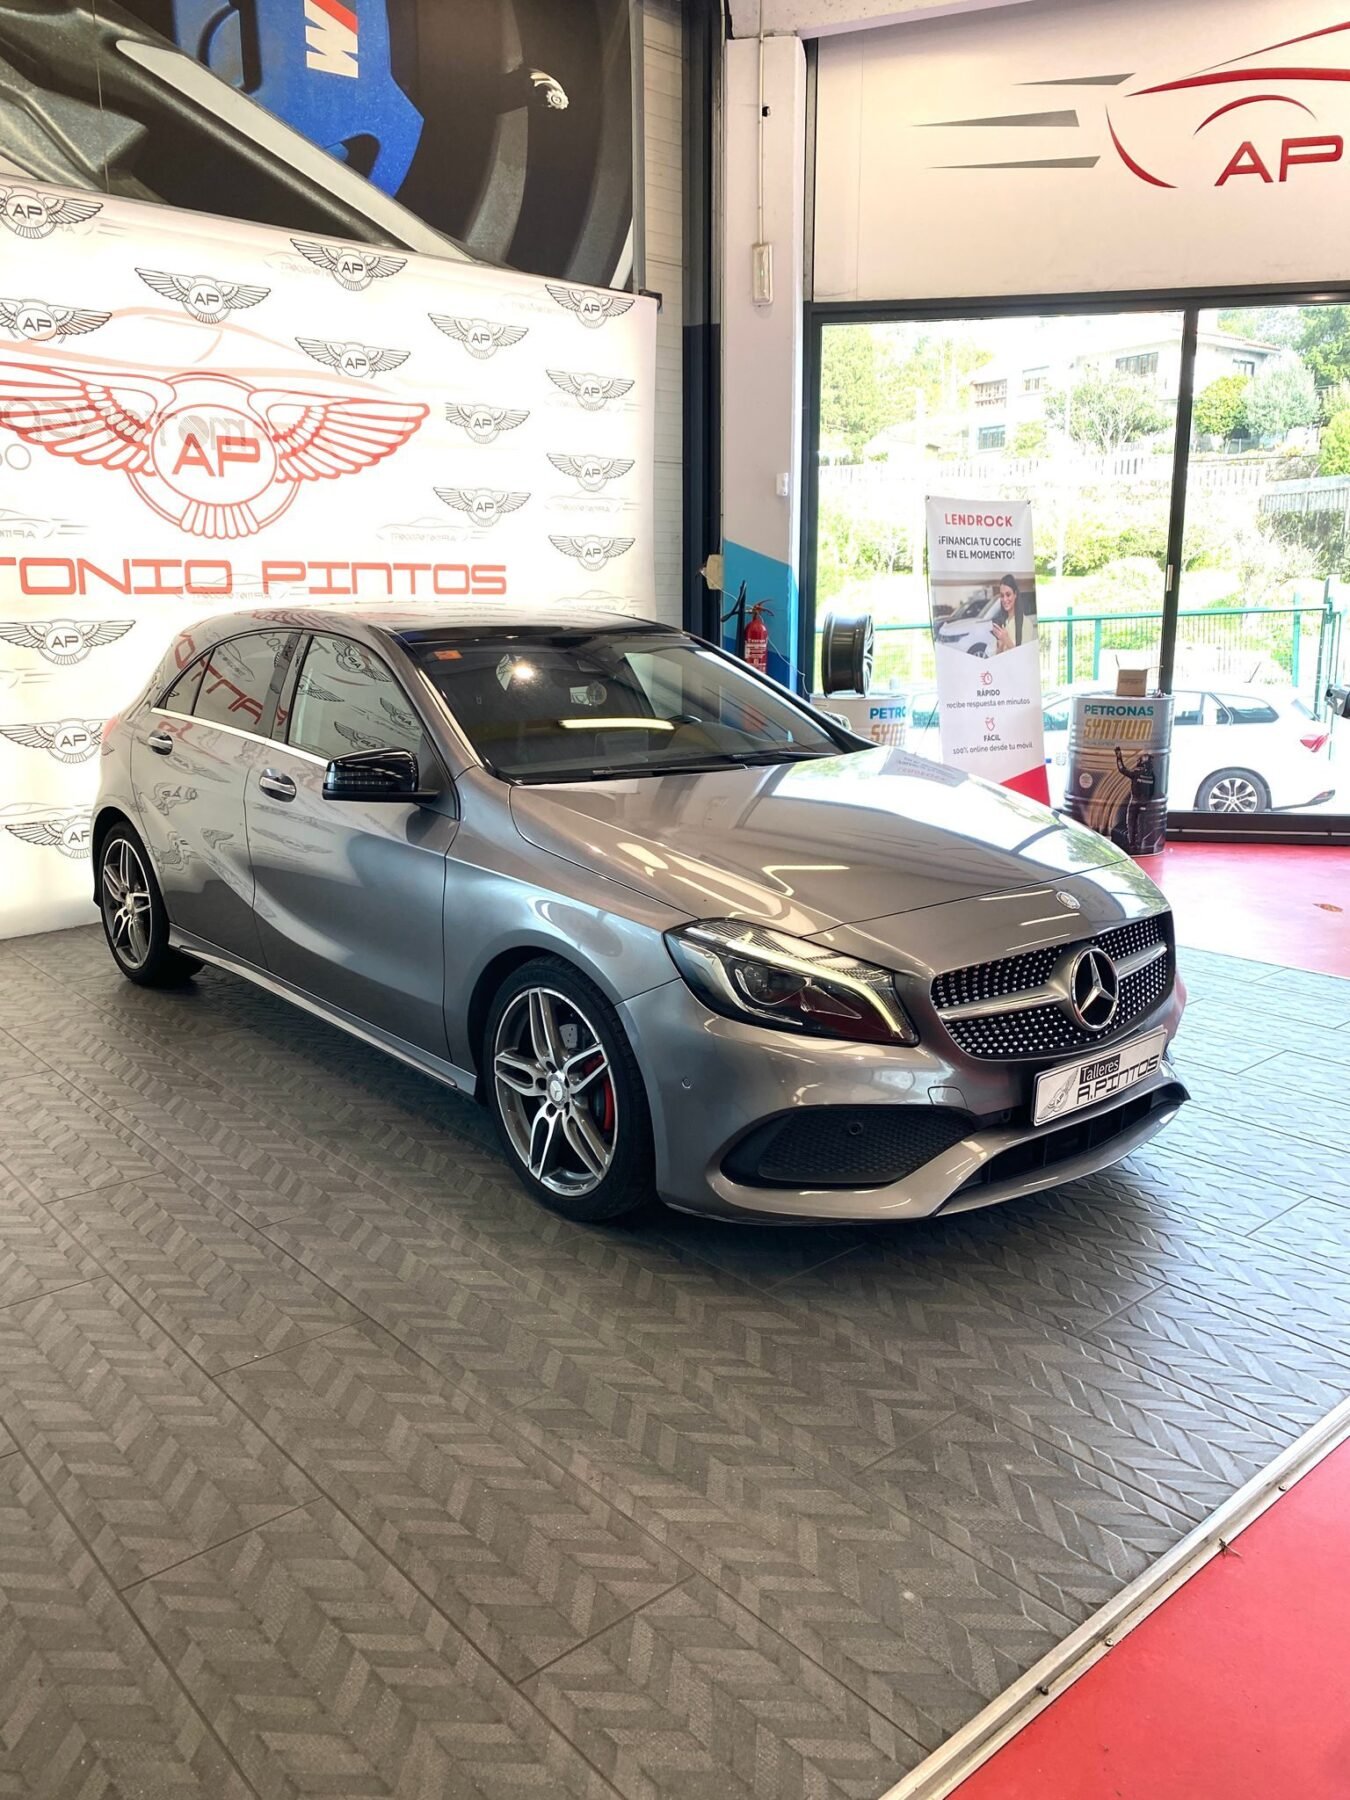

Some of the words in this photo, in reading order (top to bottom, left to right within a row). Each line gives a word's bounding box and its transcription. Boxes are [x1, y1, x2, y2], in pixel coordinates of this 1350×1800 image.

[1213, 134, 1344, 187] AP
[13, 203, 42, 219] AP
[341, 261, 364, 274] AP
[194, 292, 219, 306] AP
[583, 303, 600, 314] AP
[23, 317, 52, 331] AP
[471, 332, 491, 344] AP
[345, 358, 367, 369] AP
[583, 387, 600, 396] AP
[473, 418, 492, 429] AP
[171, 432, 261, 477] AP
[584, 468, 601, 477] AP
[476, 502, 494, 512] AP
[945, 513, 1013, 528] LENDROCK
[939, 536, 979, 547] ¡FINANCIA
[980, 537, 991, 547] TU
[993, 537, 1022, 547] COCHE
[585, 548, 601, 557] AP
[946, 550, 957, 559] EN
[959, 550, 969, 559] EL
[970, 550, 1015, 560] MOMENTO!
[261, 560, 506, 595] PINTOS
[51, 636, 79, 649] AP
[1084, 704, 1154, 716] PETRONAS
[1083, 718, 1153, 740] SYNTIUM
[60, 734, 88, 746] AP
[953, 747, 969, 755] 100%
[970, 745, 988, 753] online
[990, 743, 1008, 752] desde
[1081, 1059, 1119, 1083] Talleres
